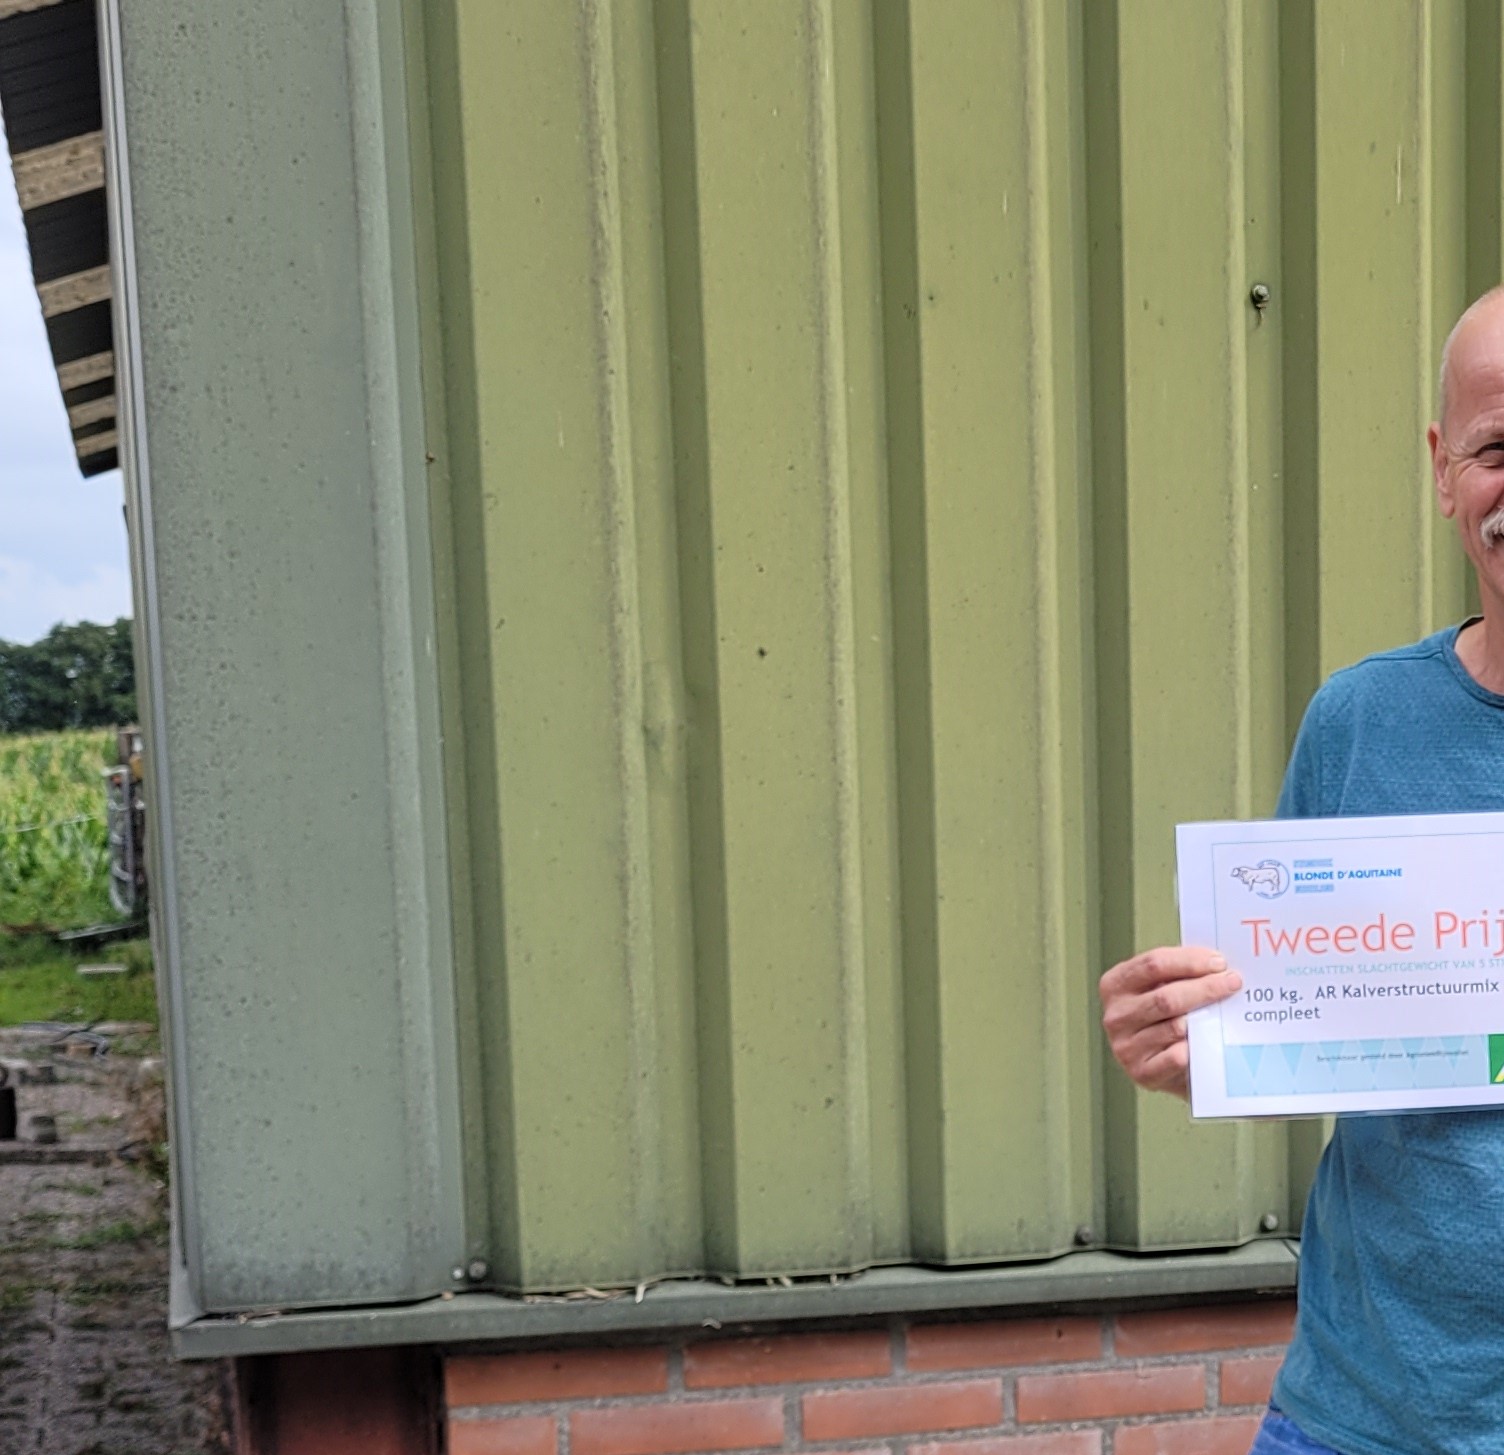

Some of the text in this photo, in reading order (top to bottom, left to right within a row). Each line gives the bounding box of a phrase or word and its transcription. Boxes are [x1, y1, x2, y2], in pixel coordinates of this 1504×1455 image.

[1294, 868, 1403, 881] BLONDE D'AQUITAINE
[1241, 912, 1415, 957] Tweede
[1285, 965, 1354, 976] INSCHATTEN
[1358, 960, 1449, 974] SLACHTGEWICHT
[1453, 959, 1475, 970] VAN
[1479, 958, 1486, 968] 5
[1245, 978, 1500, 1004] 100 kg. AR Kalverstructuurmix
[1244, 1006, 1321, 1024] compleet
